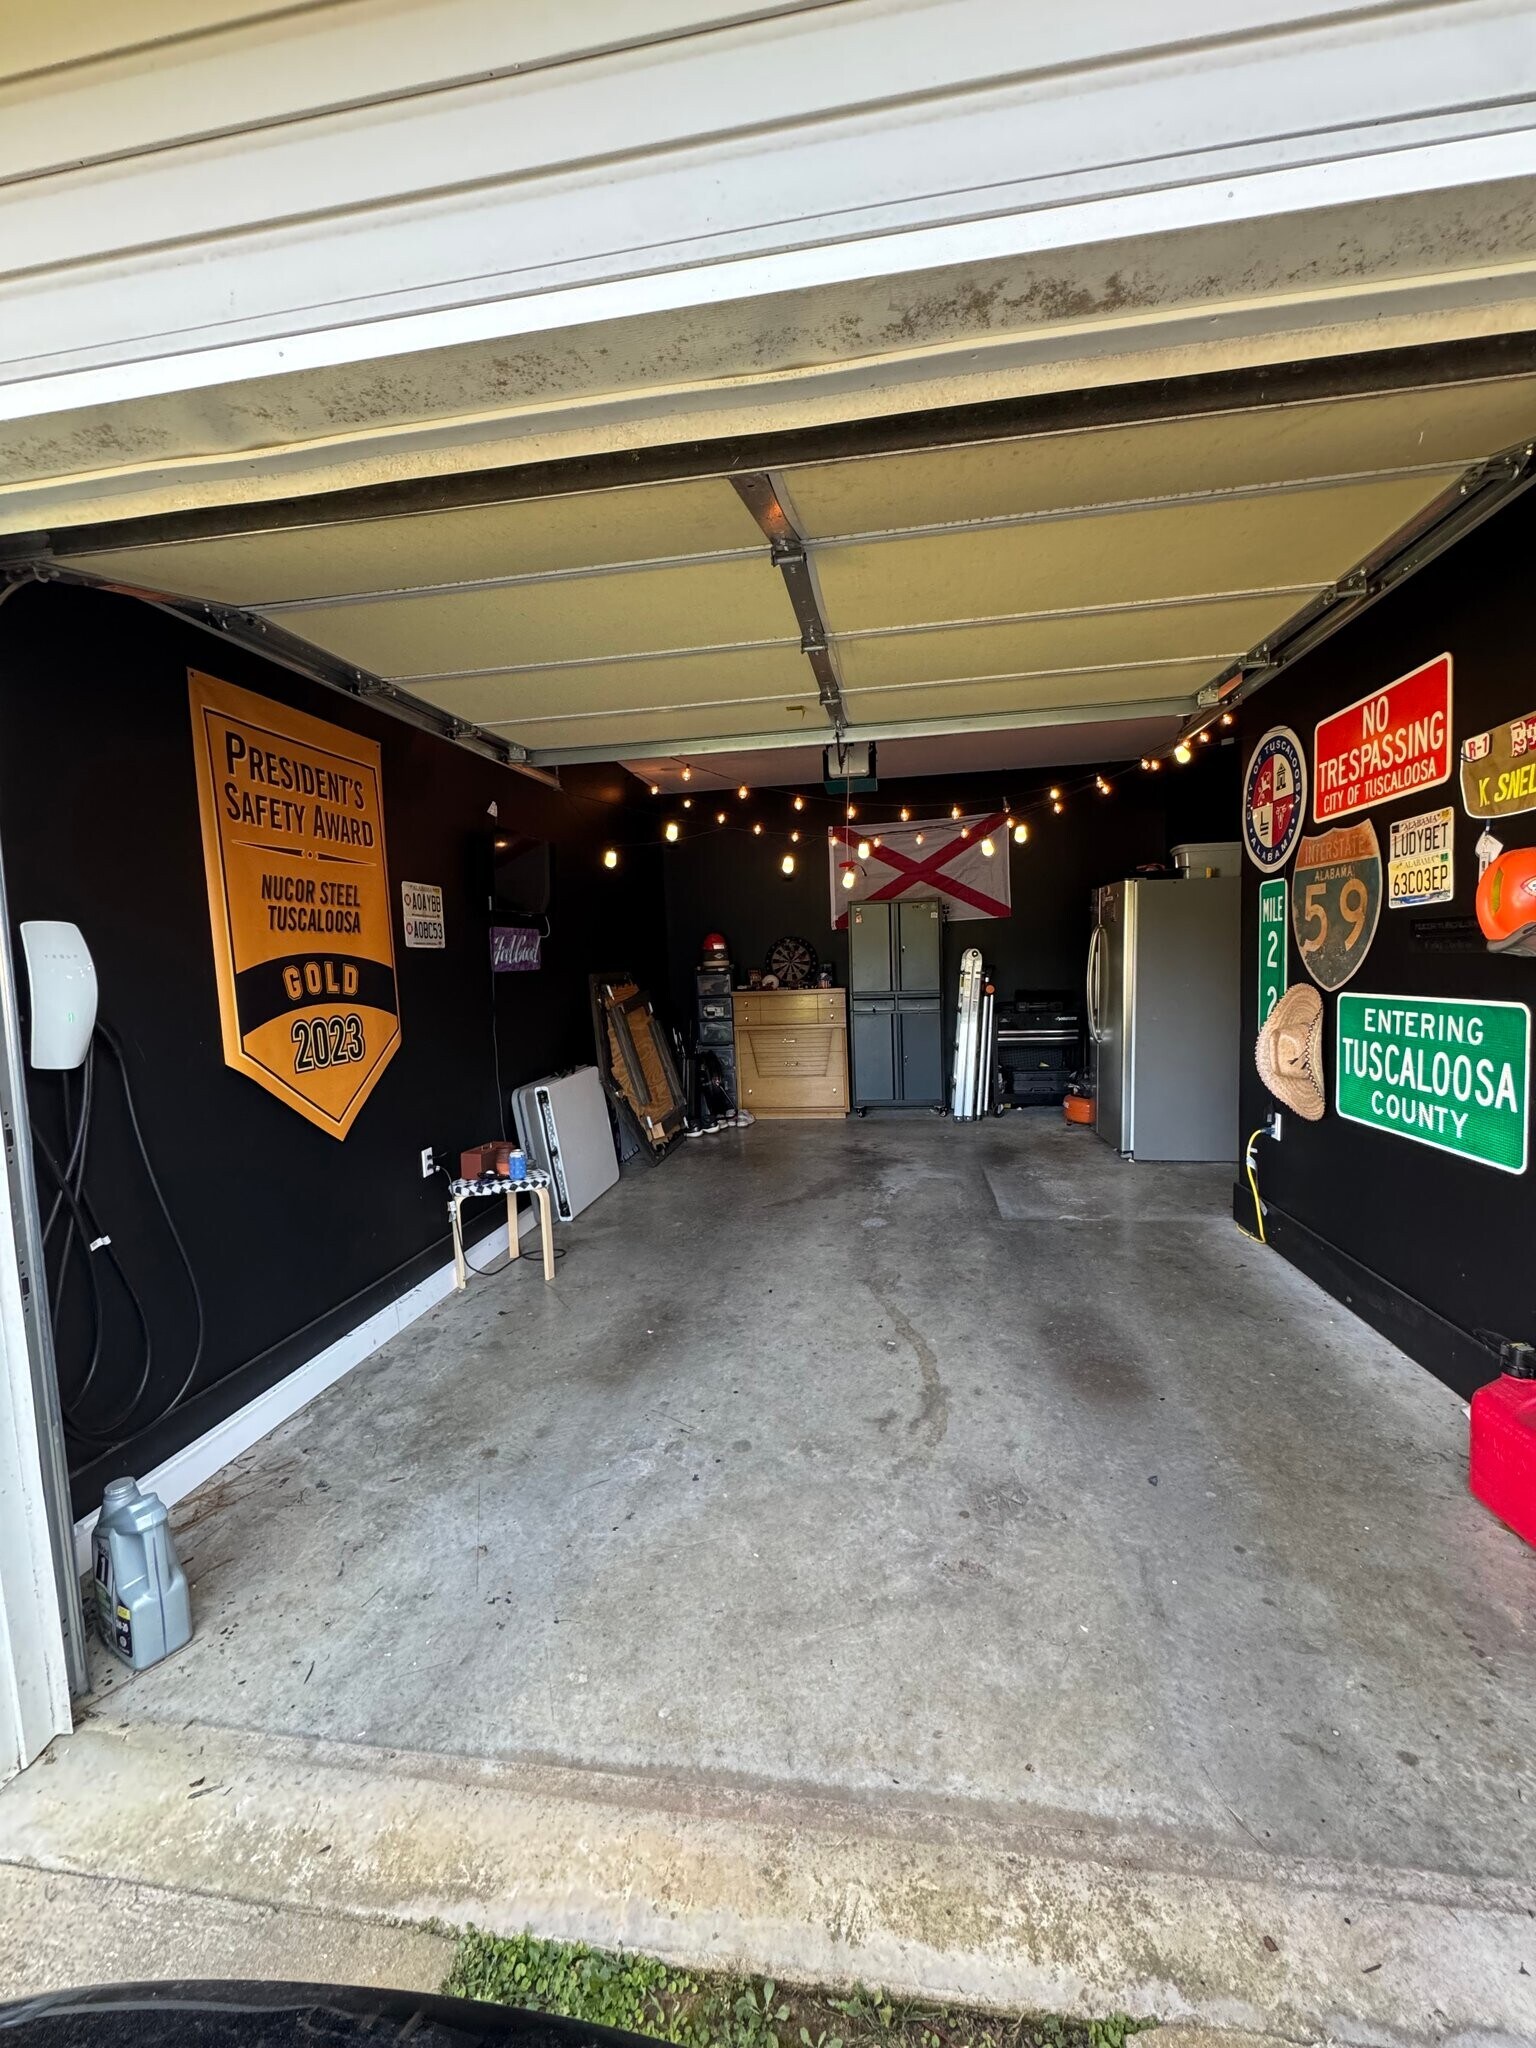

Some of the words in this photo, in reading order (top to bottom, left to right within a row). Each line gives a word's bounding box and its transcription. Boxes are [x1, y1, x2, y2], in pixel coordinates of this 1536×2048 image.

[1363, 696, 1389, 739] NO
[1319, 710, 1444, 792] TRESPASSING
[1468, 736, 1488, 760] R-1
[225, 730, 365, 811] PRESIDENT'S
[1253, 757, 1263, 775] OF
[1264, 740, 1301, 803] TUSCALOOSA
[1324, 790, 1344, 813] CITY
[1347, 784, 1360, 805] OF
[1365, 757, 1436, 799] TUSCALOOSA
[224, 782, 306, 836] SAFETY
[313, 804, 374, 848] AWARD
[1250, 828, 1294, 862] ALABAMA
[1305, 835, 1367, 864] INTERSTATE
[1394, 822, 1449, 858] LUDYBET
[262, 874, 315, 904] NUCOR
[319, 881, 360, 907] STEEL
[1315, 865, 1353, 881] ALABAMA
[268, 905, 361, 933] TUSCALOOSA
[1263, 896, 1283, 922] MILE
[1302, 878, 1368, 952] 59
[1267, 930, 1278, 968] 2
[282, 961, 359, 1000] GOLD
[291, 1013, 365, 1073] 2023
[1364, 1007, 1483, 1046] ENTERING
[1342, 1037, 1518, 1113] TUSCALOOSA
[1371, 1090, 1469, 1138] COUNTY
